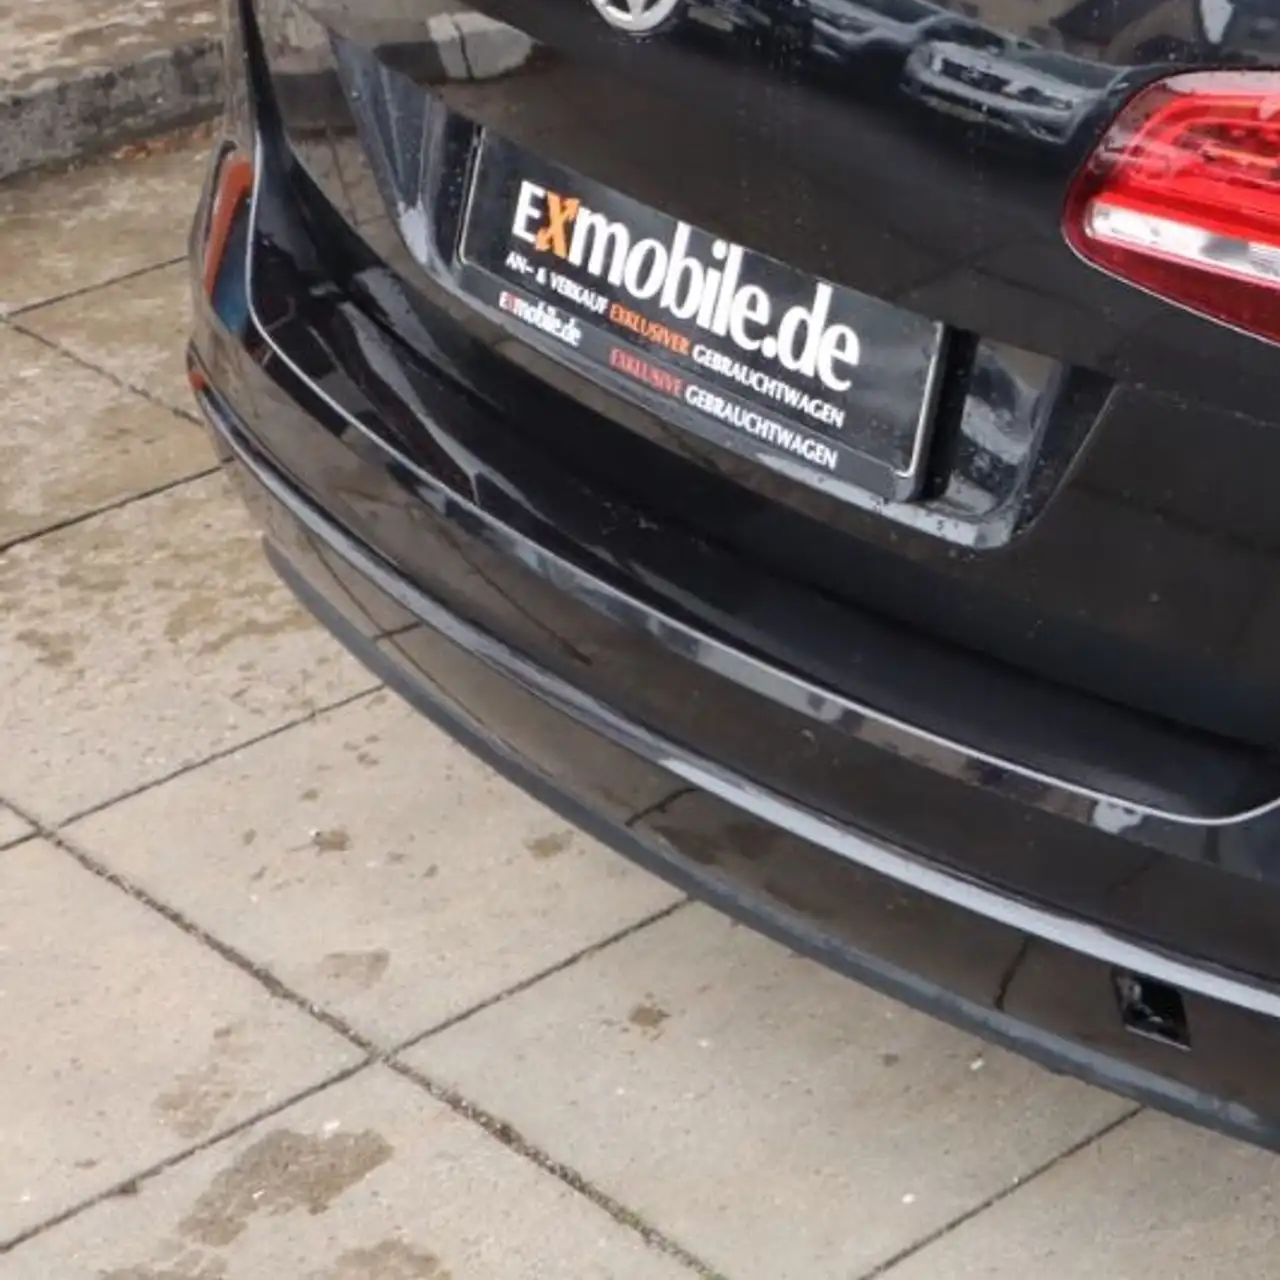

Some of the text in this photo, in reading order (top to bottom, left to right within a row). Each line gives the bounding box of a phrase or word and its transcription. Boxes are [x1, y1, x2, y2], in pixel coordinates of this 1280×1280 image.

[512, 180, 861, 392] EXmobile.de
[549, 272, 609, 314] VERKAUF
[609, 302, 692, 356] EXKLUSIVER
[692, 344, 846, 429] GEBRAUCHTWAGEN
[610, 347, 684, 397] EXKLUSIVE
[685, 384, 839, 470] GEBRAUCHTWAGEN
